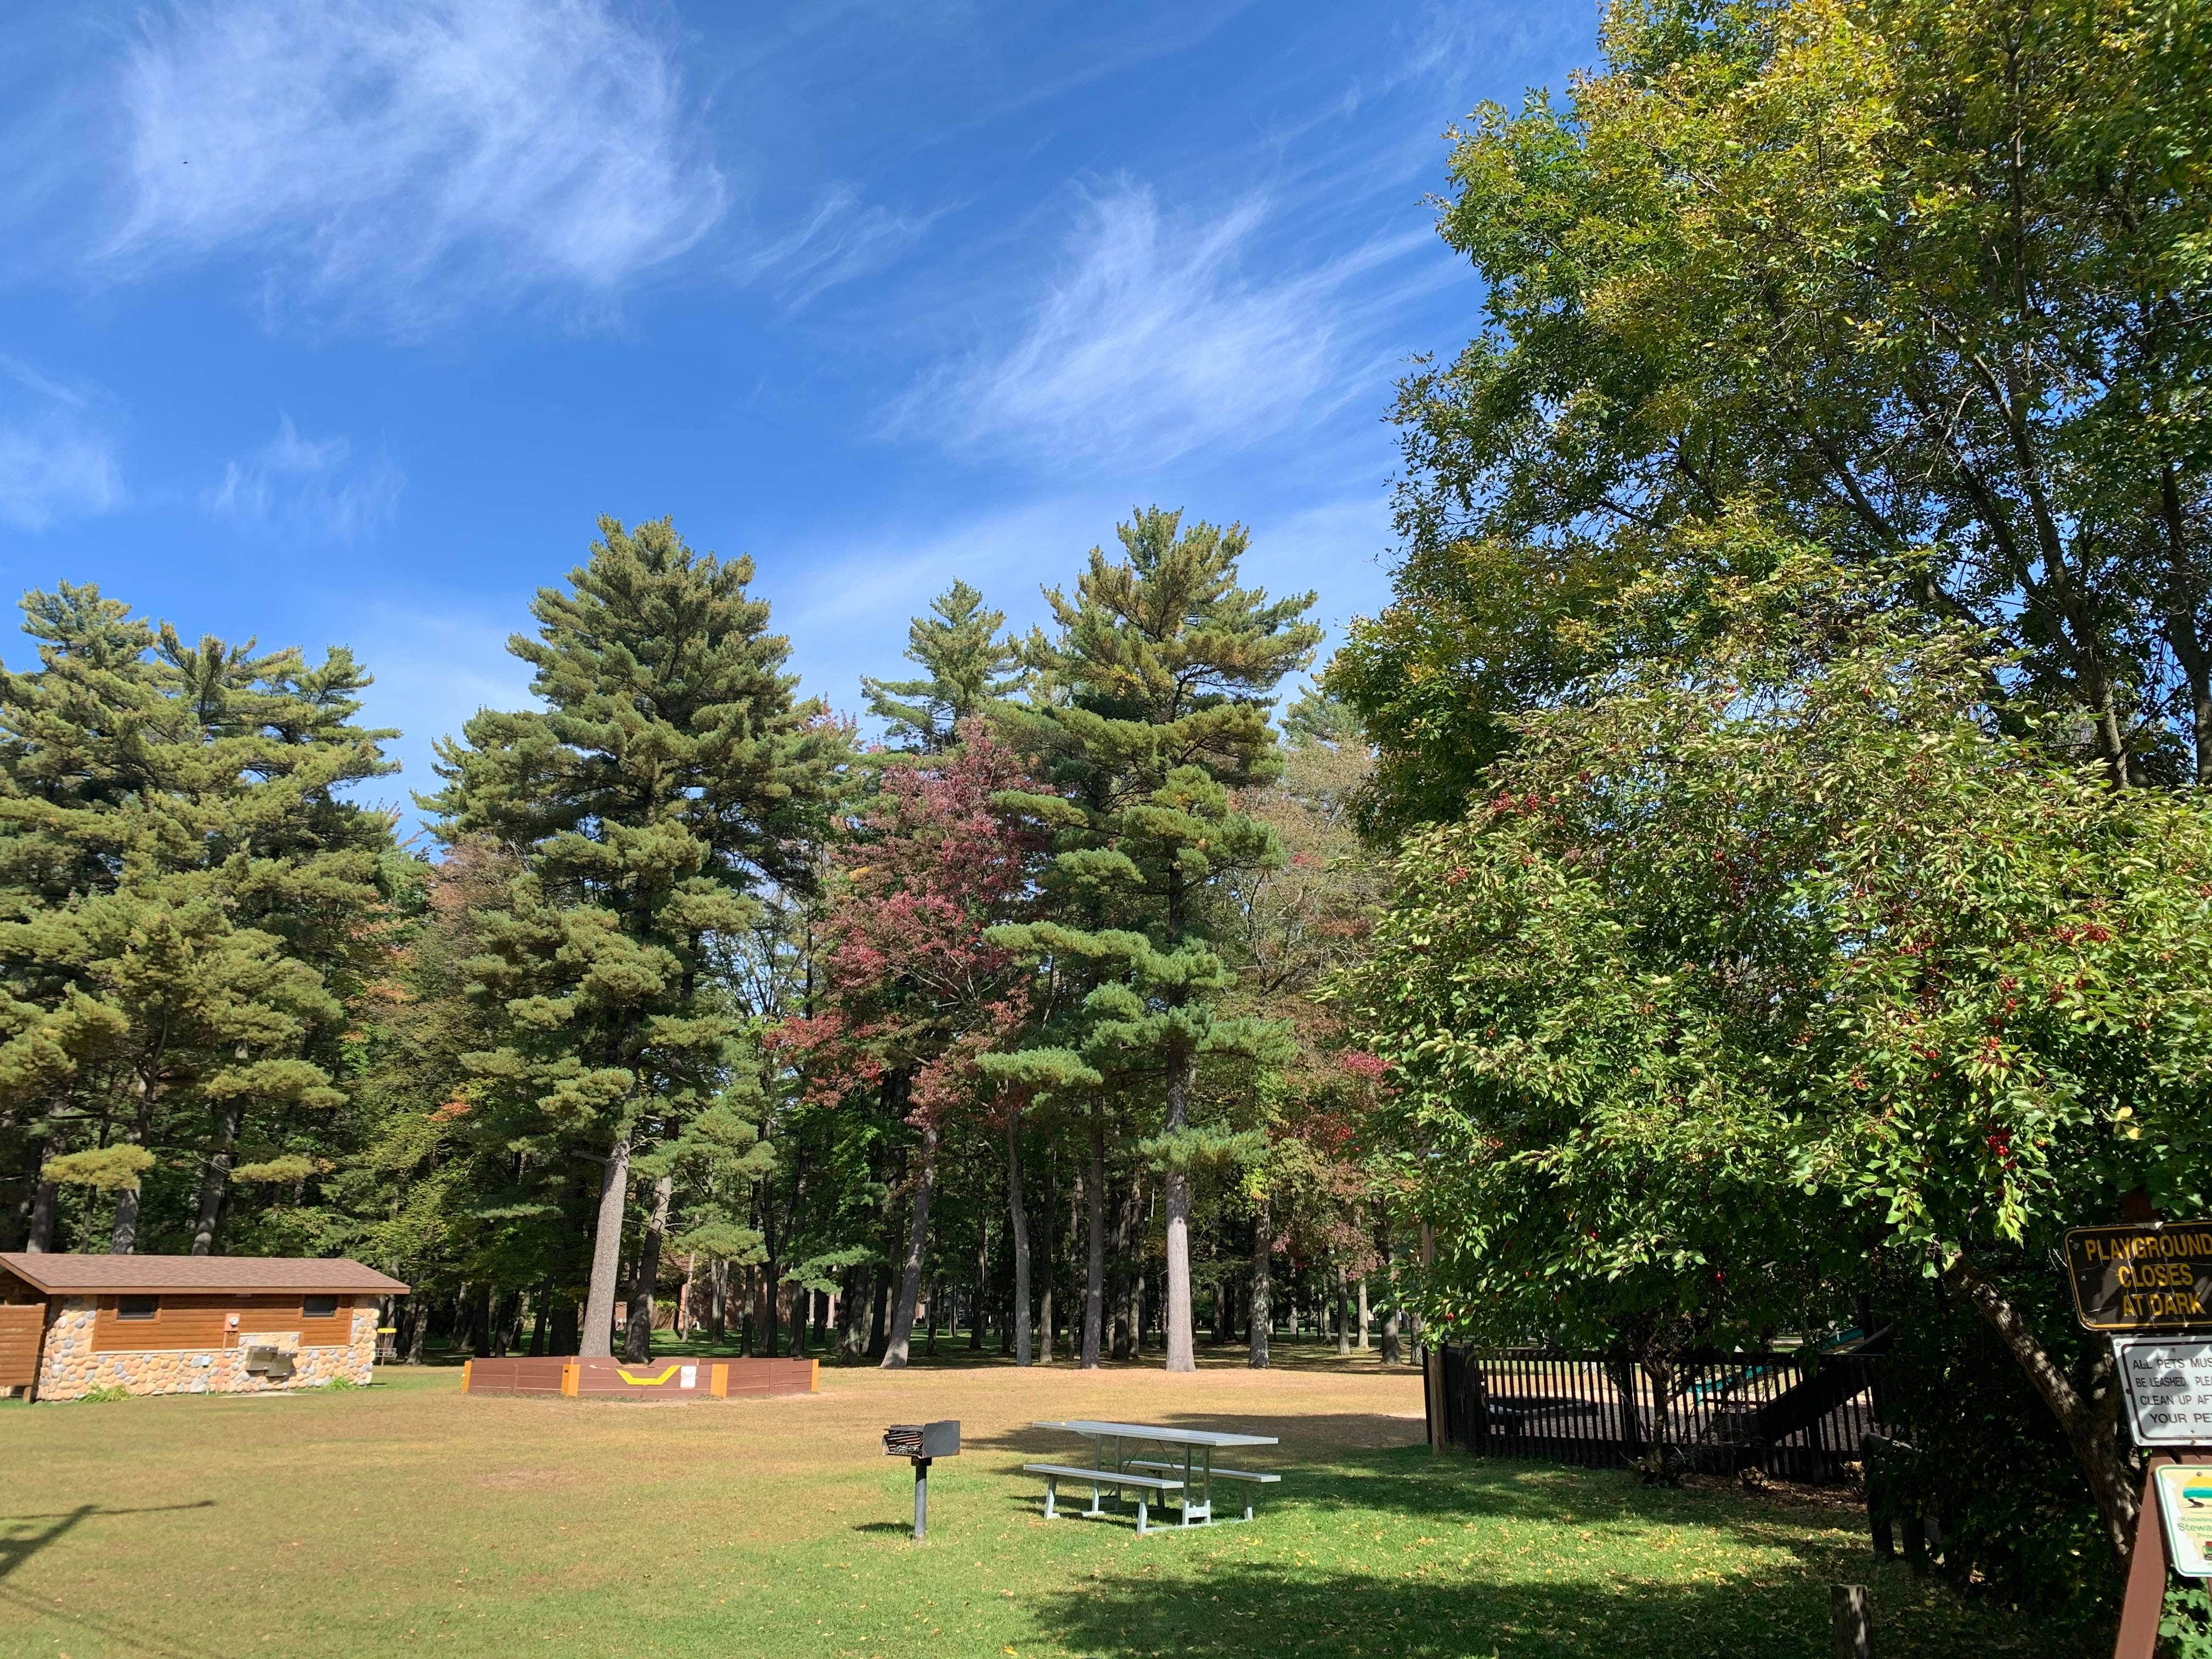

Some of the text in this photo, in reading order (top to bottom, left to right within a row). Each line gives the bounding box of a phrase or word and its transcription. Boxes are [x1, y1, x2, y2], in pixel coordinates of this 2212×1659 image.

[2085, 1233, 2212, 1261] PLAYGROUND
[2118, 1263, 2193, 1288] CLOSES
[2123, 1293, 2207, 1317] AT DARK
[2133, 1359, 2153, 1369] ALL
[2157, 1358, 2185, 1369] PETS
[2135, 1376, 2212, 1387] BE LEASHED. PLE
[2140, 1395, 2174, 1406] CLEAN
[2178, 1395, 2192, 1405] UP
[2149, 1413, 2212, 1424] YOUR PE
